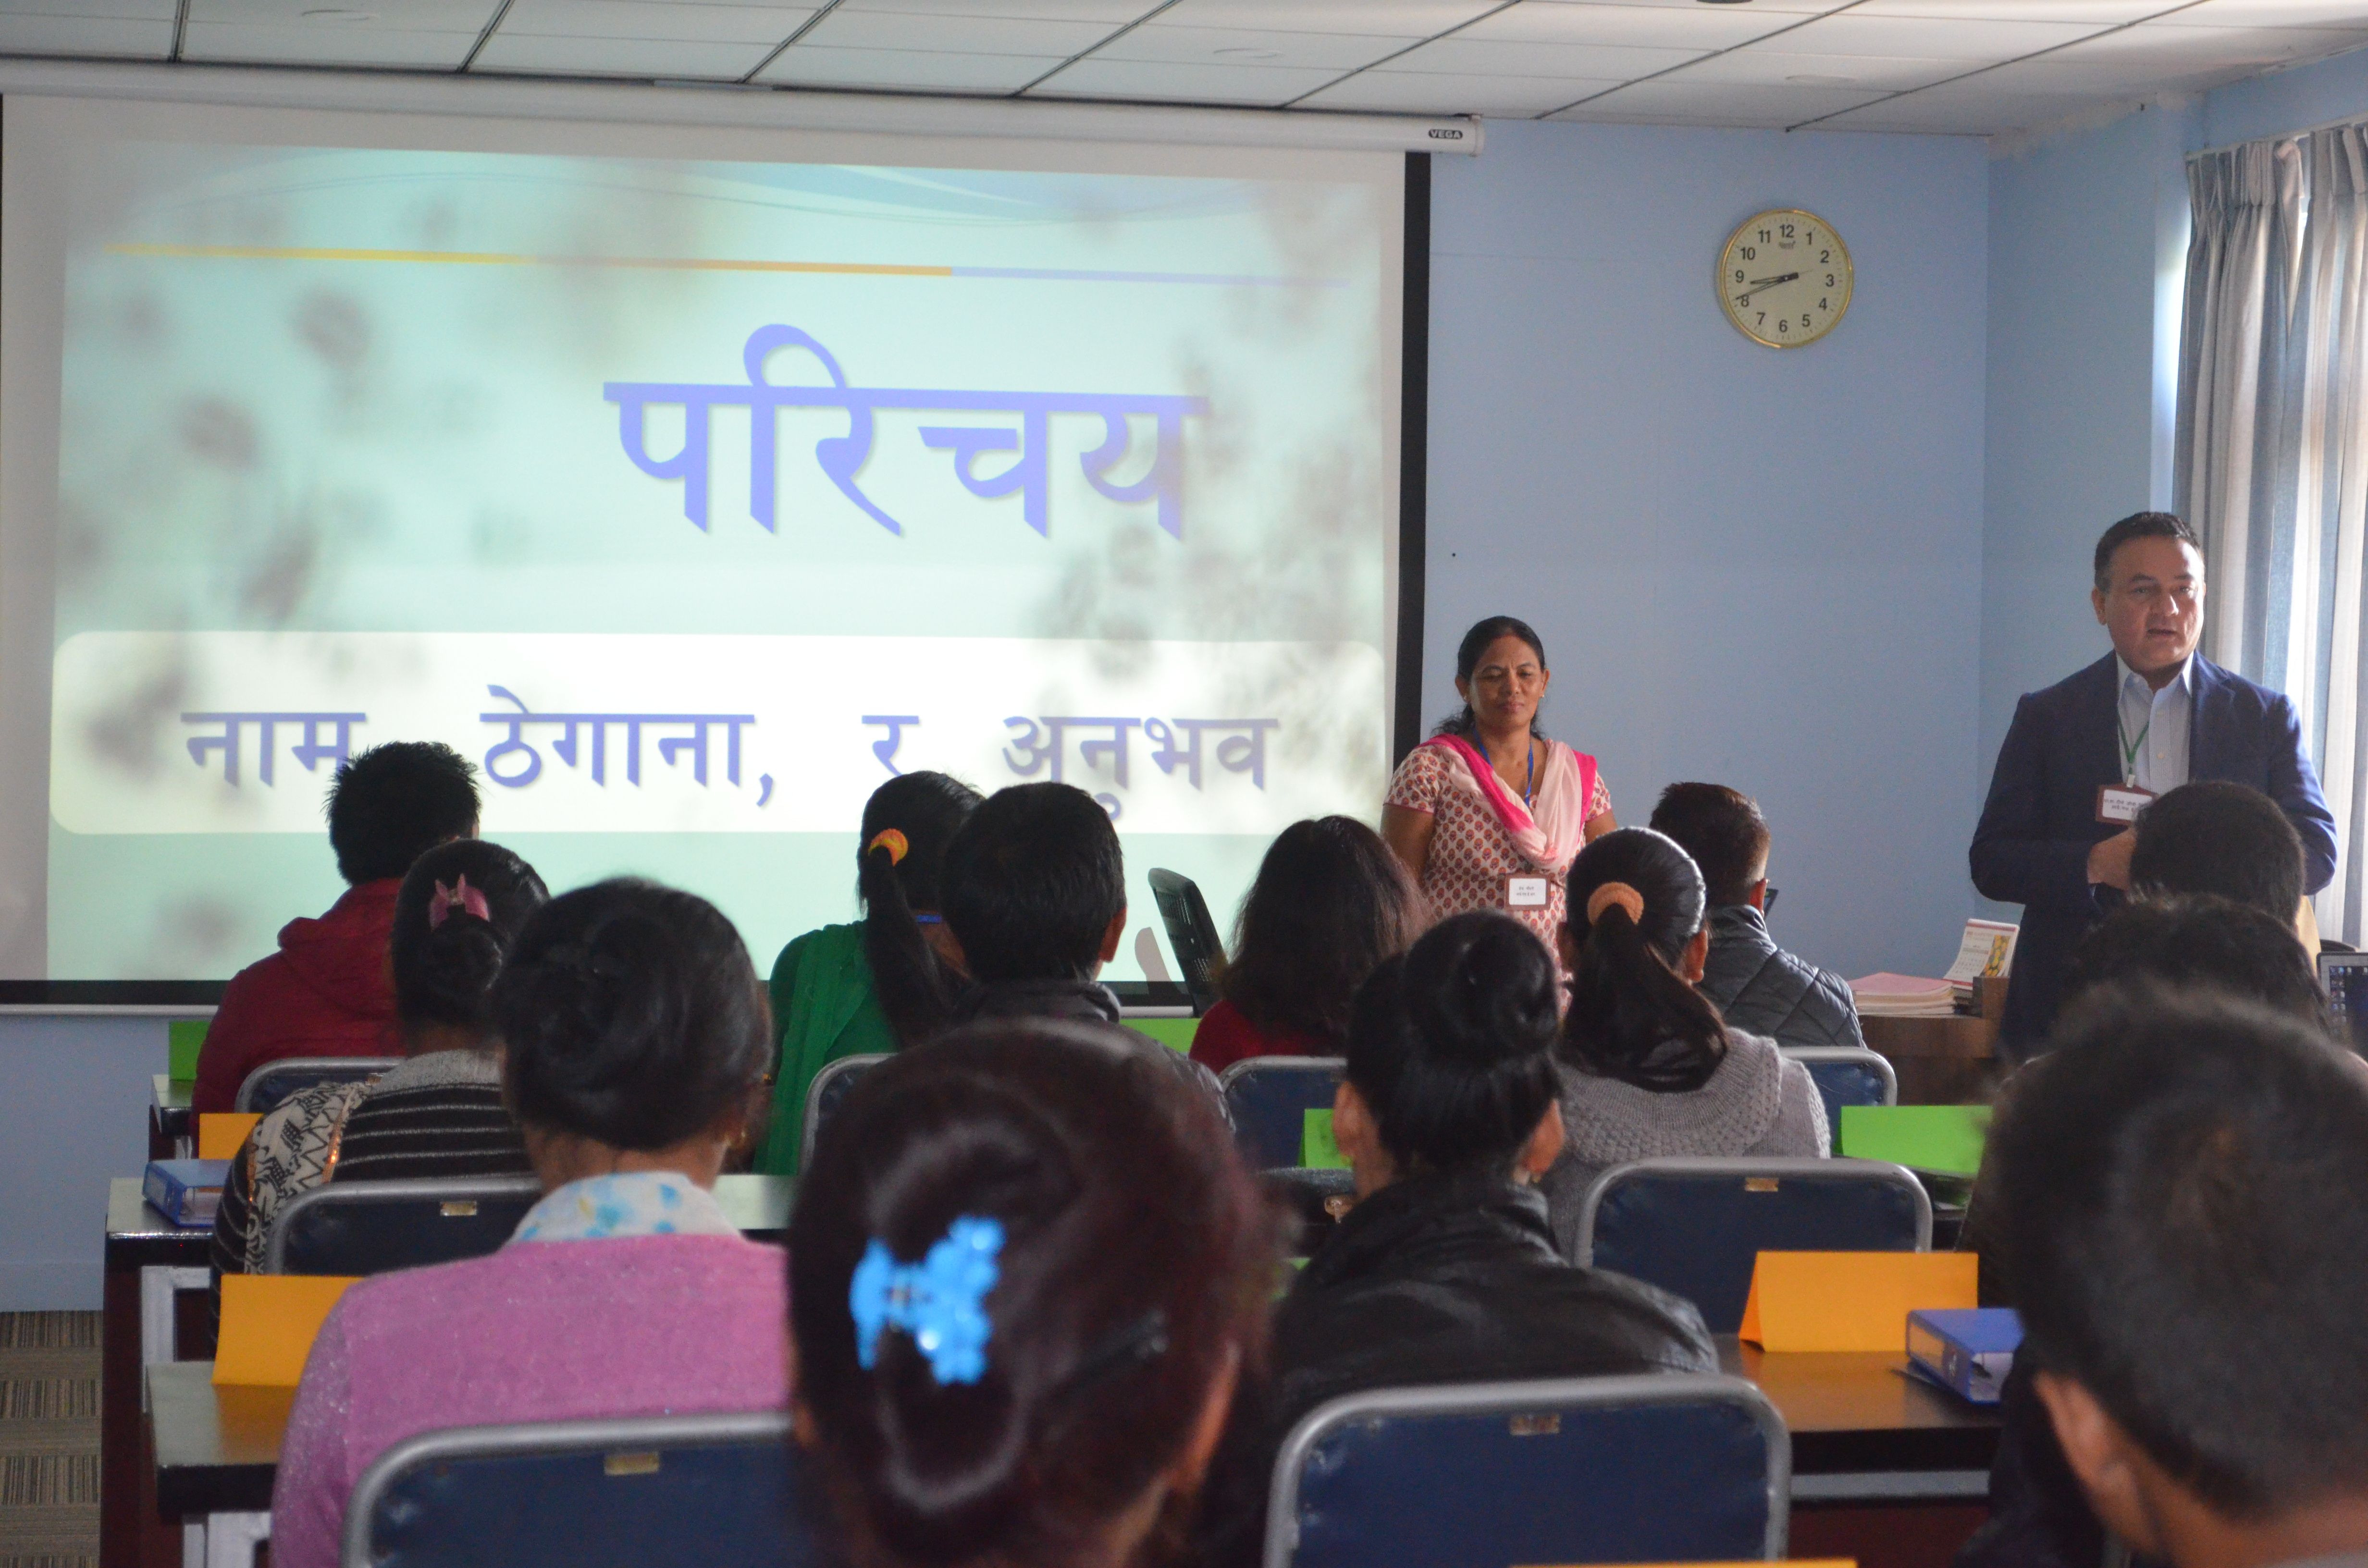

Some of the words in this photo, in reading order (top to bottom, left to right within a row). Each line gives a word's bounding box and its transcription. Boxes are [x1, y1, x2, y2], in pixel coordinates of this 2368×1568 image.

[1430, 129, 1461, 139] VEGA
[1758, 230, 1771, 243] 11
[1779, 224, 1794, 238] 12
[1806, 232, 1812, 245] 1
[1740, 247, 1755, 260] 10
[1820, 250, 1829, 264] 2
[1735, 270, 1744, 283] 9
[1825, 274, 1834, 287] 3
[1740, 294, 1750, 307] 8
[1818, 297, 1827, 310] 4
[1756, 312, 1765, 325] 7
[1802, 314, 1810, 327] 5
[1779, 319, 1788, 332] 6
[603, 323, 1209, 539] परिचय
[181, 712, 366, 787] नाम
[480, 684, 774, 808] ठेगाना,
[862, 715, 919, 777] र
[1003, 715, 1279, 821] अनुभव
